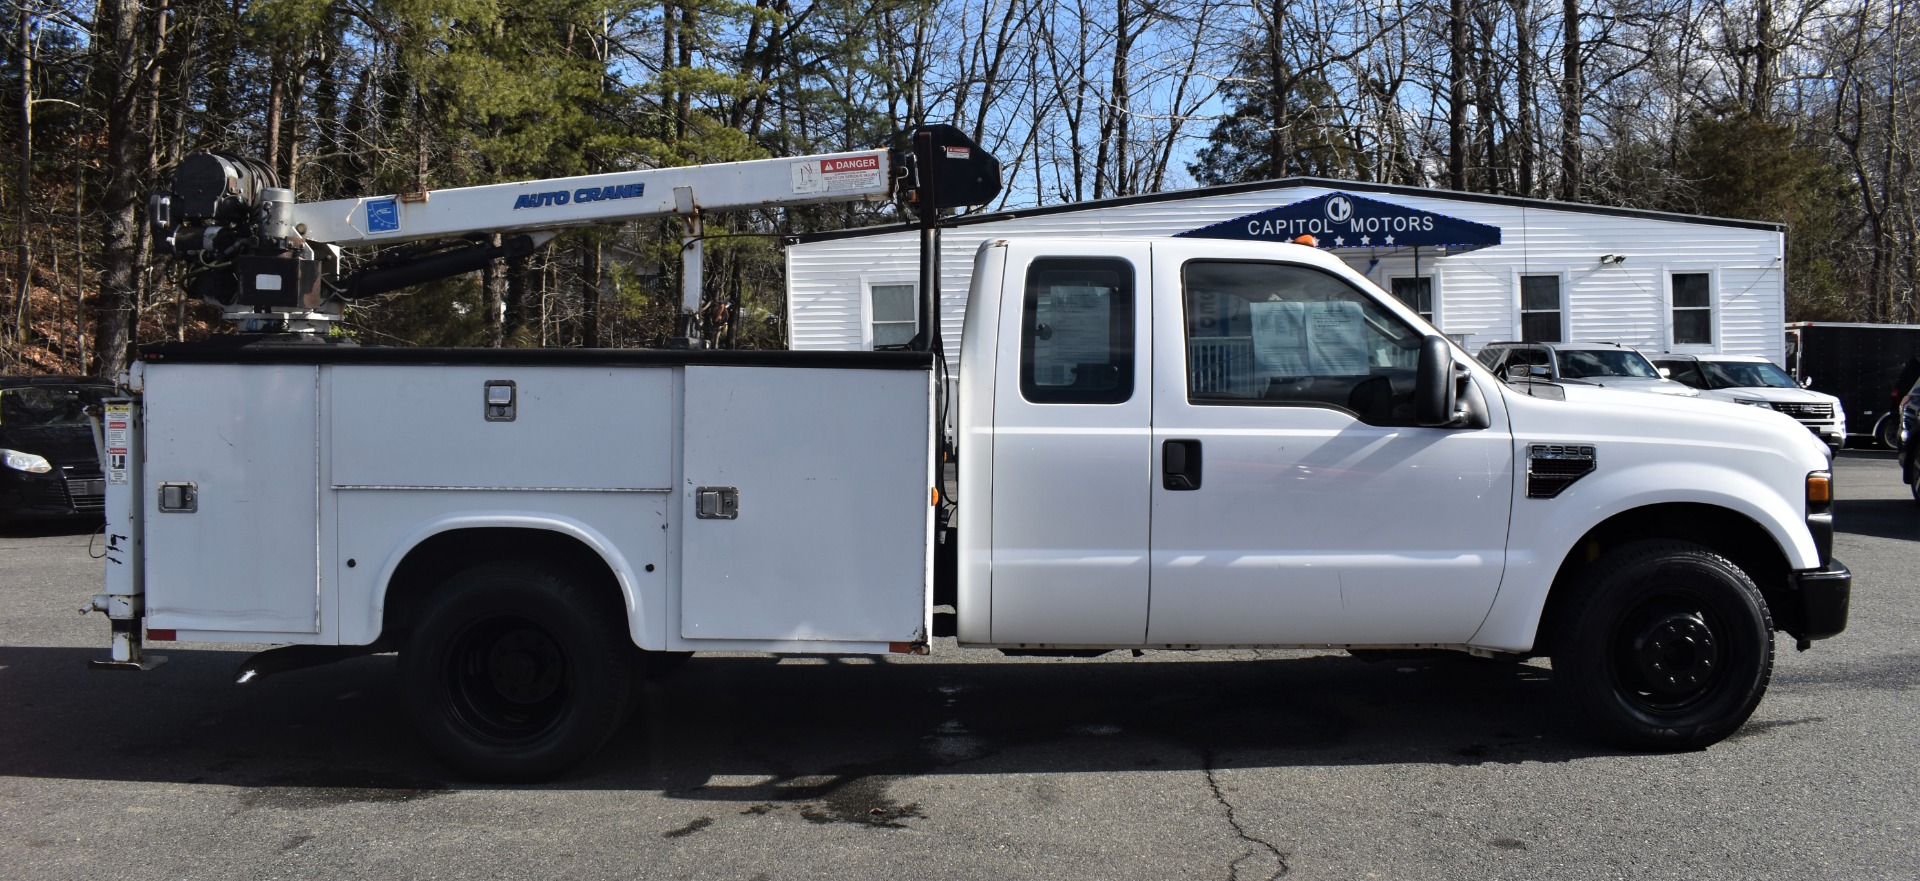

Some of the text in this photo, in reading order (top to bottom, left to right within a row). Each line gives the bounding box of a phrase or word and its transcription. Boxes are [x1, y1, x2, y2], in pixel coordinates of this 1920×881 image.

[836, 159, 875, 169] DANGER
[513, 183, 645, 209] AUTO CRANE
[1248, 216, 1433, 235] CAPITOL MOTORS
